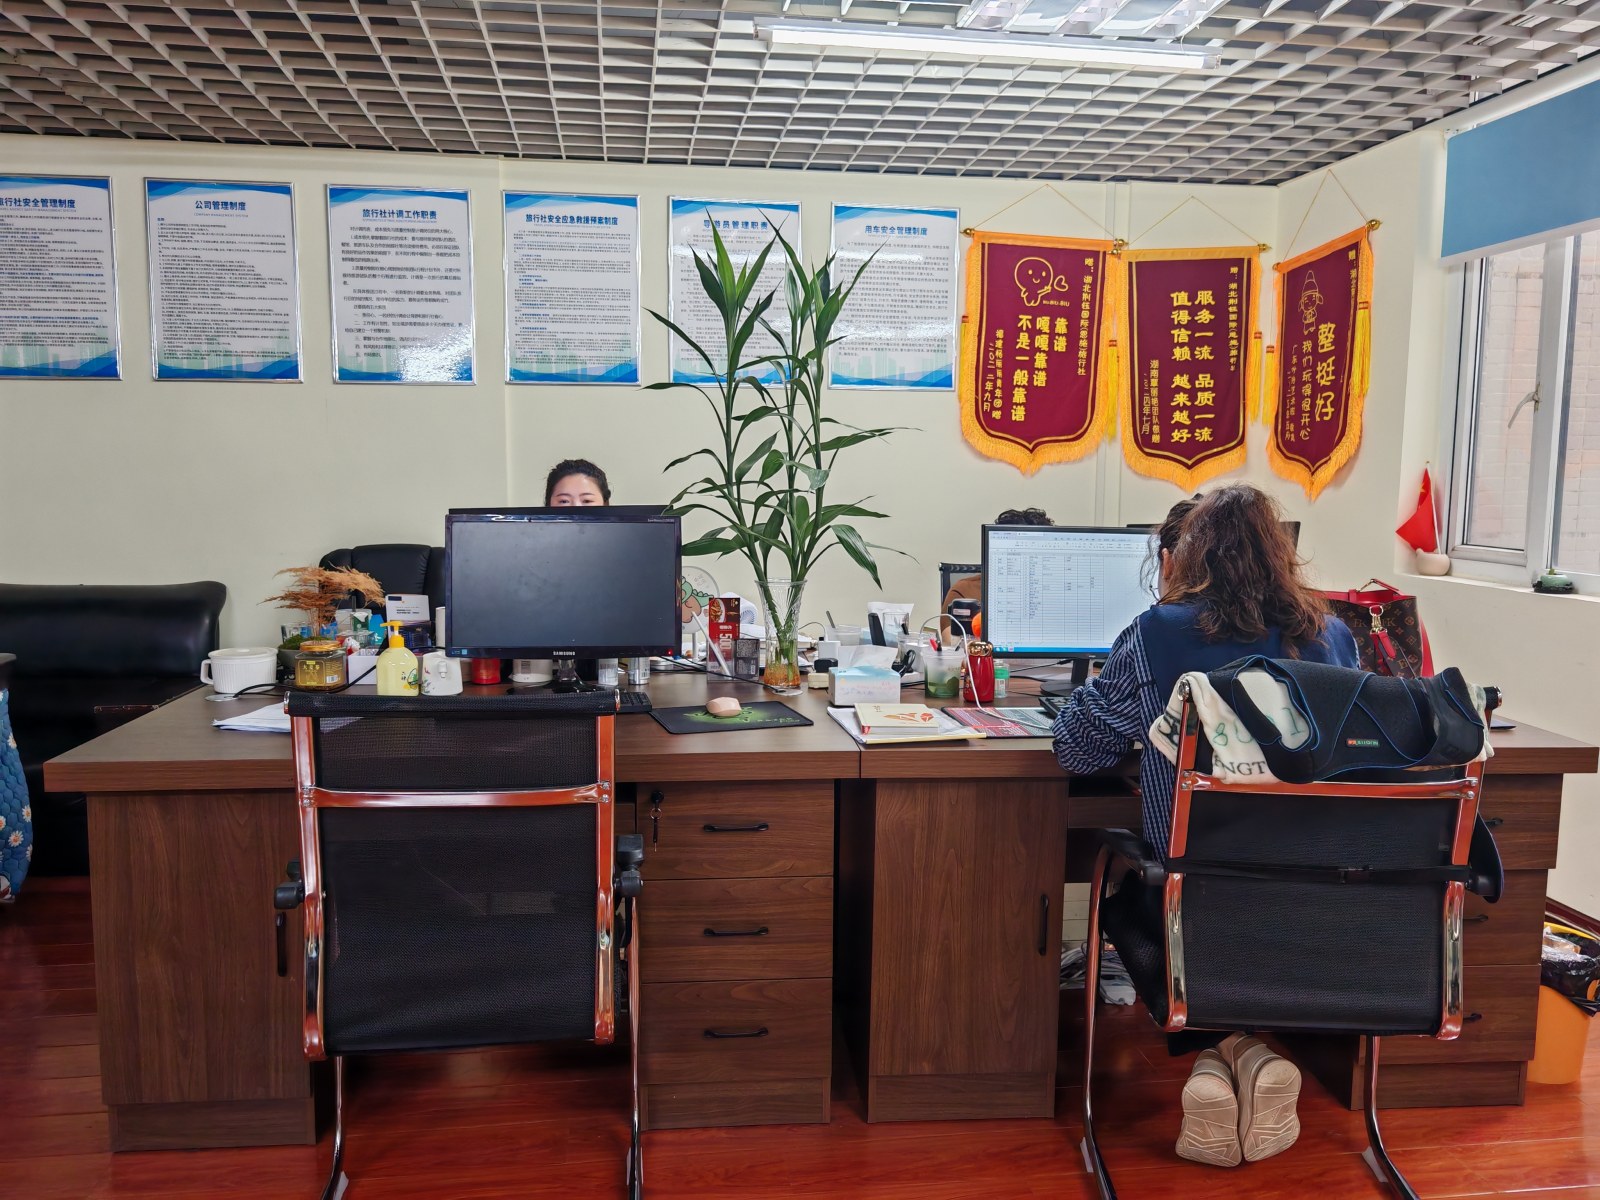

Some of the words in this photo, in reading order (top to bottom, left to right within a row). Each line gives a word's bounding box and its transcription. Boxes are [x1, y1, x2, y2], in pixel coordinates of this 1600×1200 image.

[195, 200, 247, 211] 公司管理制度
[362, 208, 437, 220] 旅行社计调工作职责
[525, 213, 619, 226] 旅行社安全应急救援预案制度
[864, 225, 928, 236] 用车安全管理制度
[1053, 317, 1069, 353] 靠谱
[1032, 315, 1051, 388] 嘎嘎靠谱
[1010, 314, 1033, 423] 不是一般靠谱
[1314, 321, 1336, 423] 整挺好
[1299, 339, 1313, 442] 我们玩得很开心
[719, 633, 733, 650] 500
